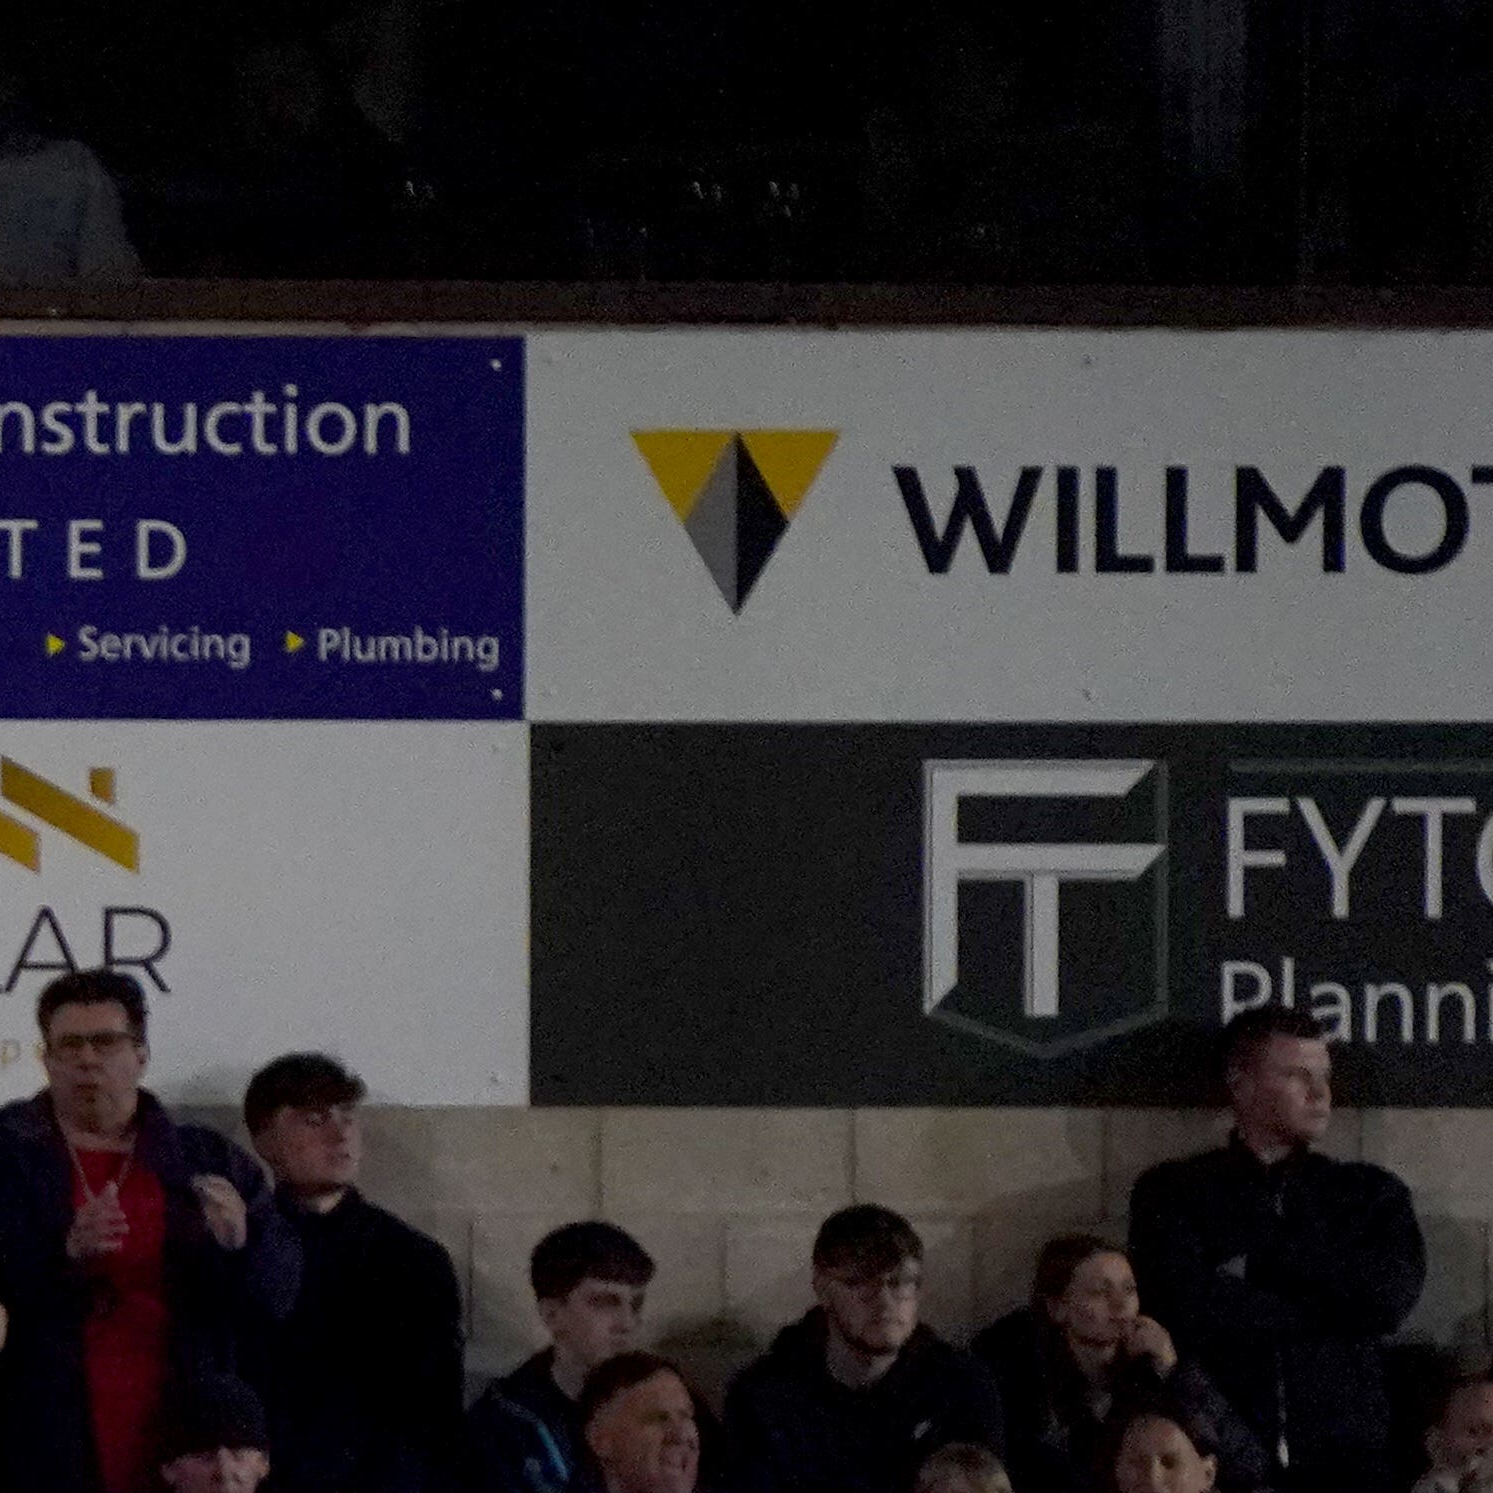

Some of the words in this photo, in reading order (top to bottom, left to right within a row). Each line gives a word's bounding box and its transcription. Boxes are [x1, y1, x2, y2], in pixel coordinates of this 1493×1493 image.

[891, 464, 1493, 576] WILLMO
[78, 625, 251, 668] Servicing
[319, 627, 500, 671] Plumbing
[1227, 797, 1493, 919] FYT
